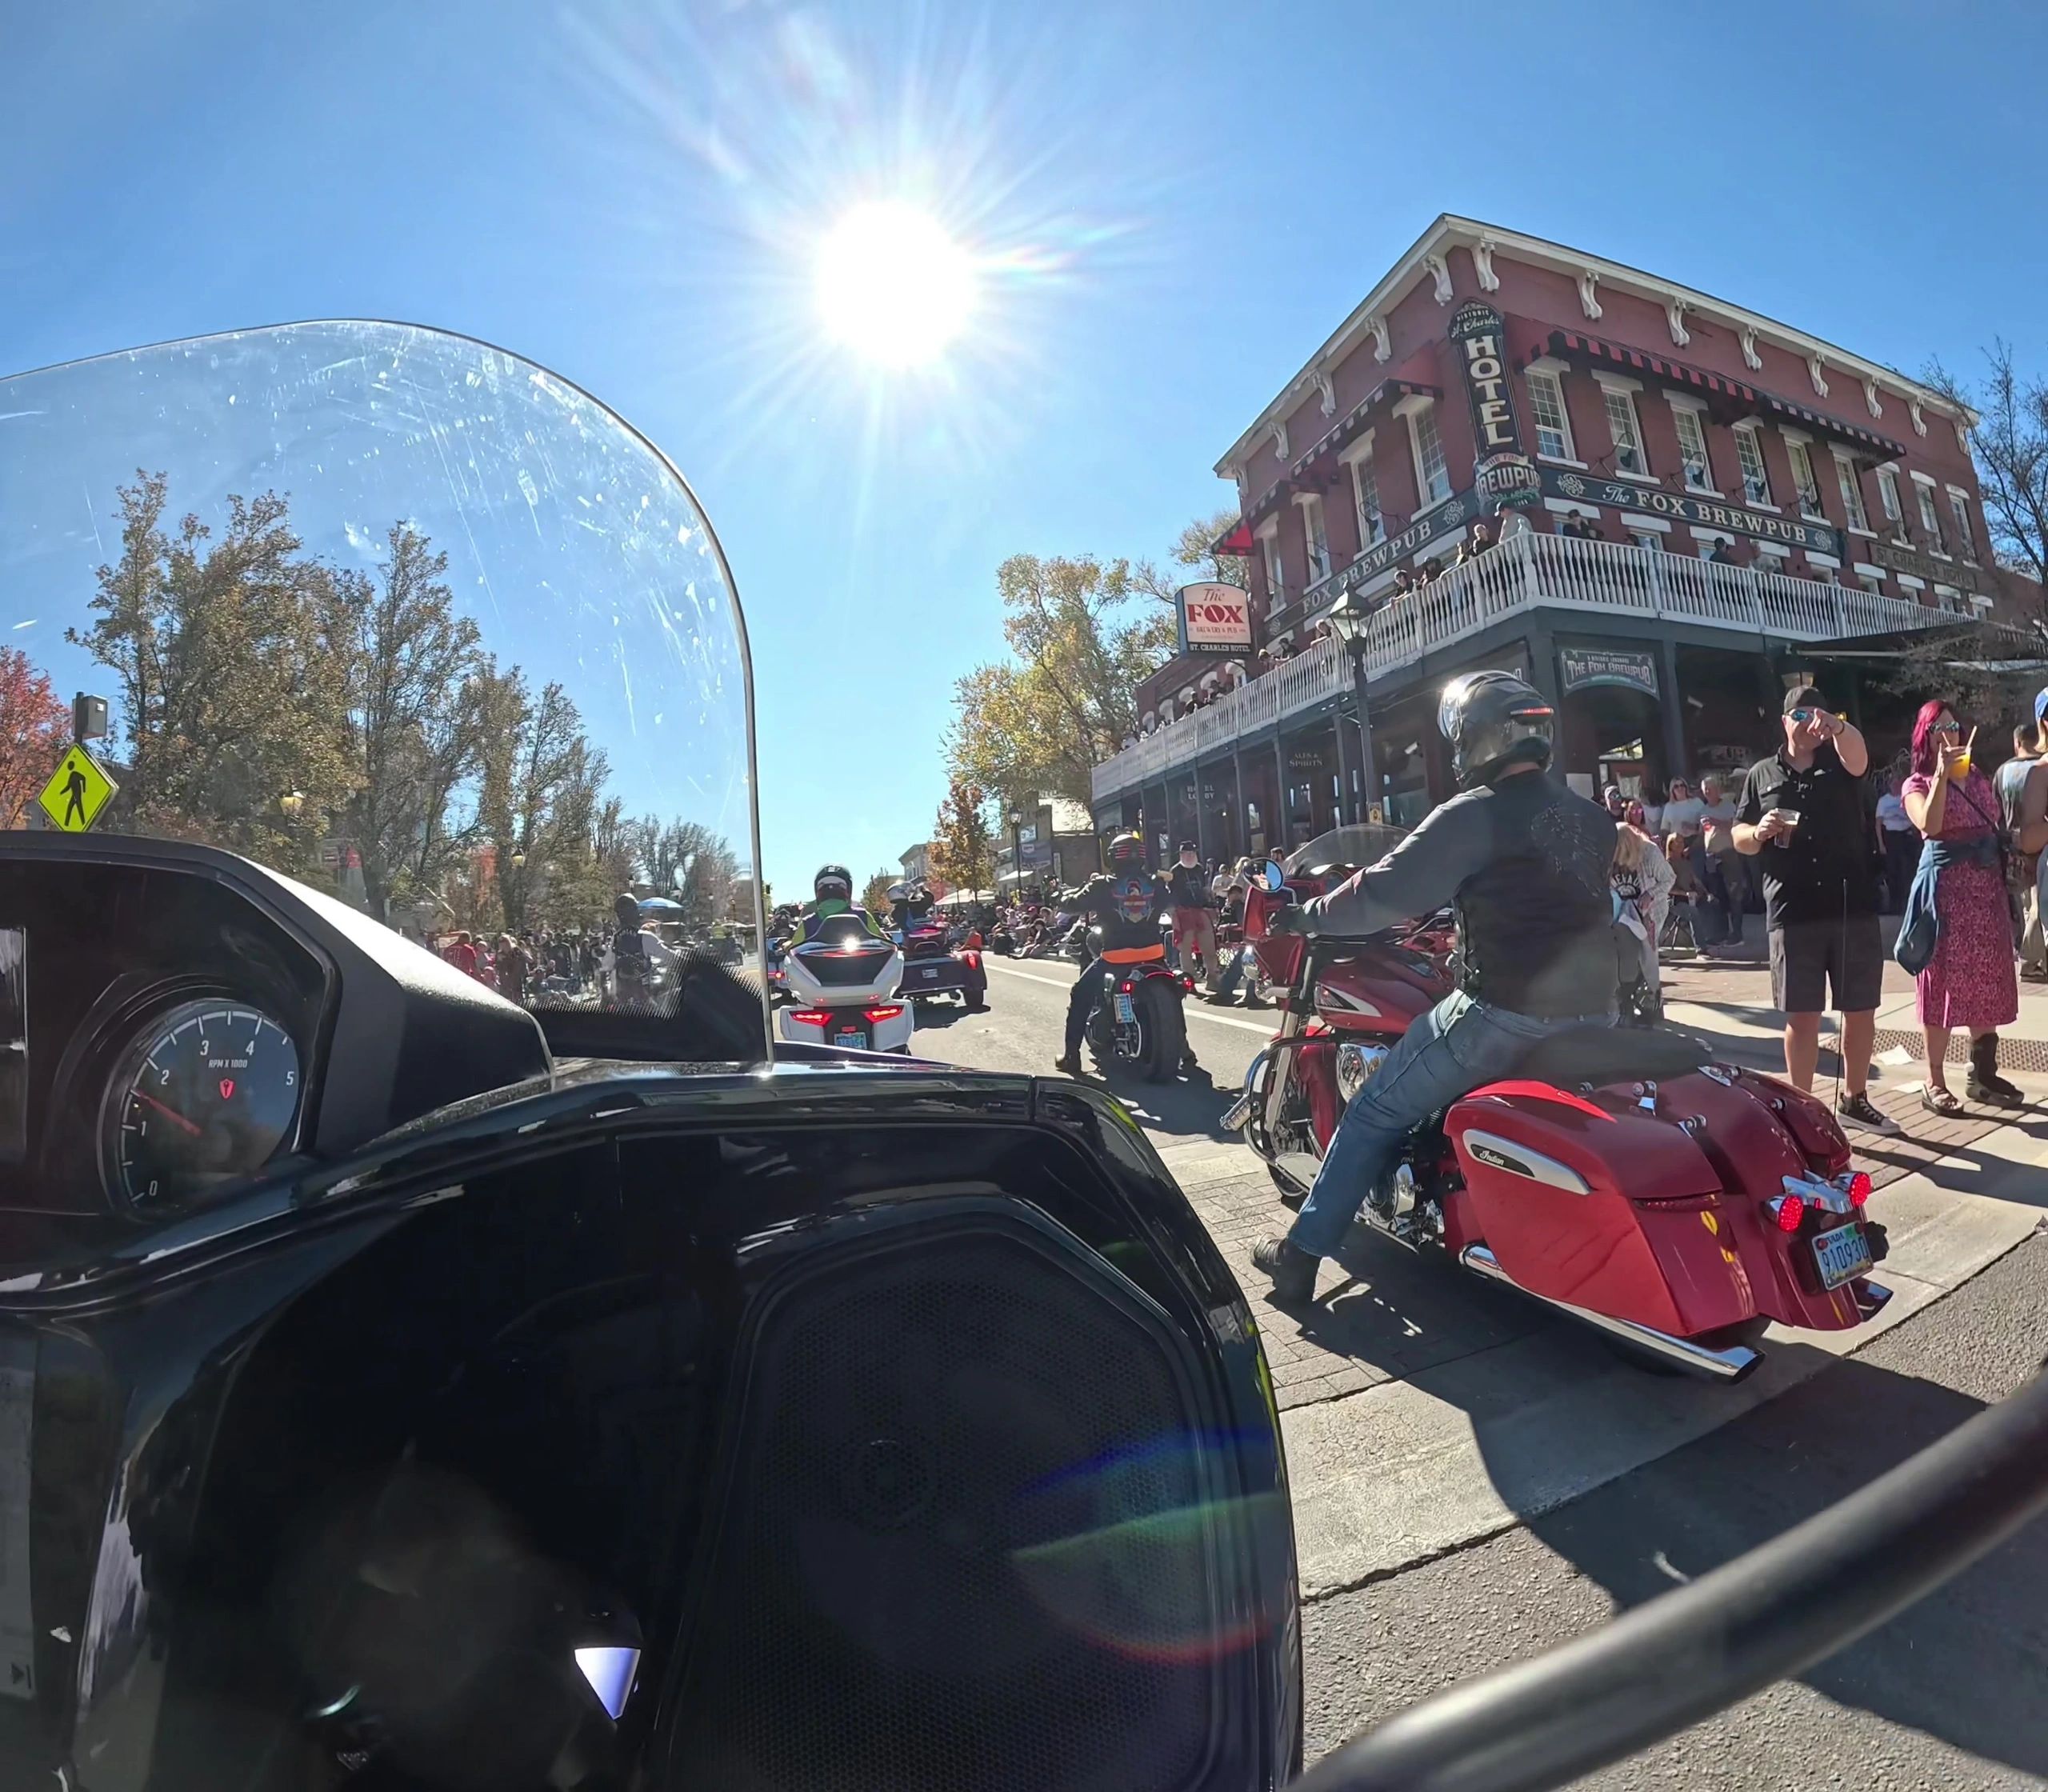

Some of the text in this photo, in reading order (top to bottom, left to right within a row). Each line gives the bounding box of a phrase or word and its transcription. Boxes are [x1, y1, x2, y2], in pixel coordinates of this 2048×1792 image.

[1465, 334, 1514, 446] HOTEL
[1602, 485, 1806, 542] The FOX BREWPUB
[1204, 588, 1225, 602] The
[1302, 588, 1332, 614] FOX
[1187, 604, 1244, 623] FOX
[1567, 660, 1586, 681] THE
[1608, 662, 1651, 685] BREWPUB
[200, 1040, 210, 1056] 3
[245, 1040, 254, 1056] 4
[208, 1059, 224, 1069] RPM
[230, 1059, 248, 1069] 1000
[161, 1070, 170, 1086] 2
[286, 1070, 294, 1086] 5
[141, 1121, 146, 1136] 1
[1479, 1150, 1505, 1166] Indian
[149, 1180, 158, 1196] 0
[1822, 1236, 1869, 1274] 910930
